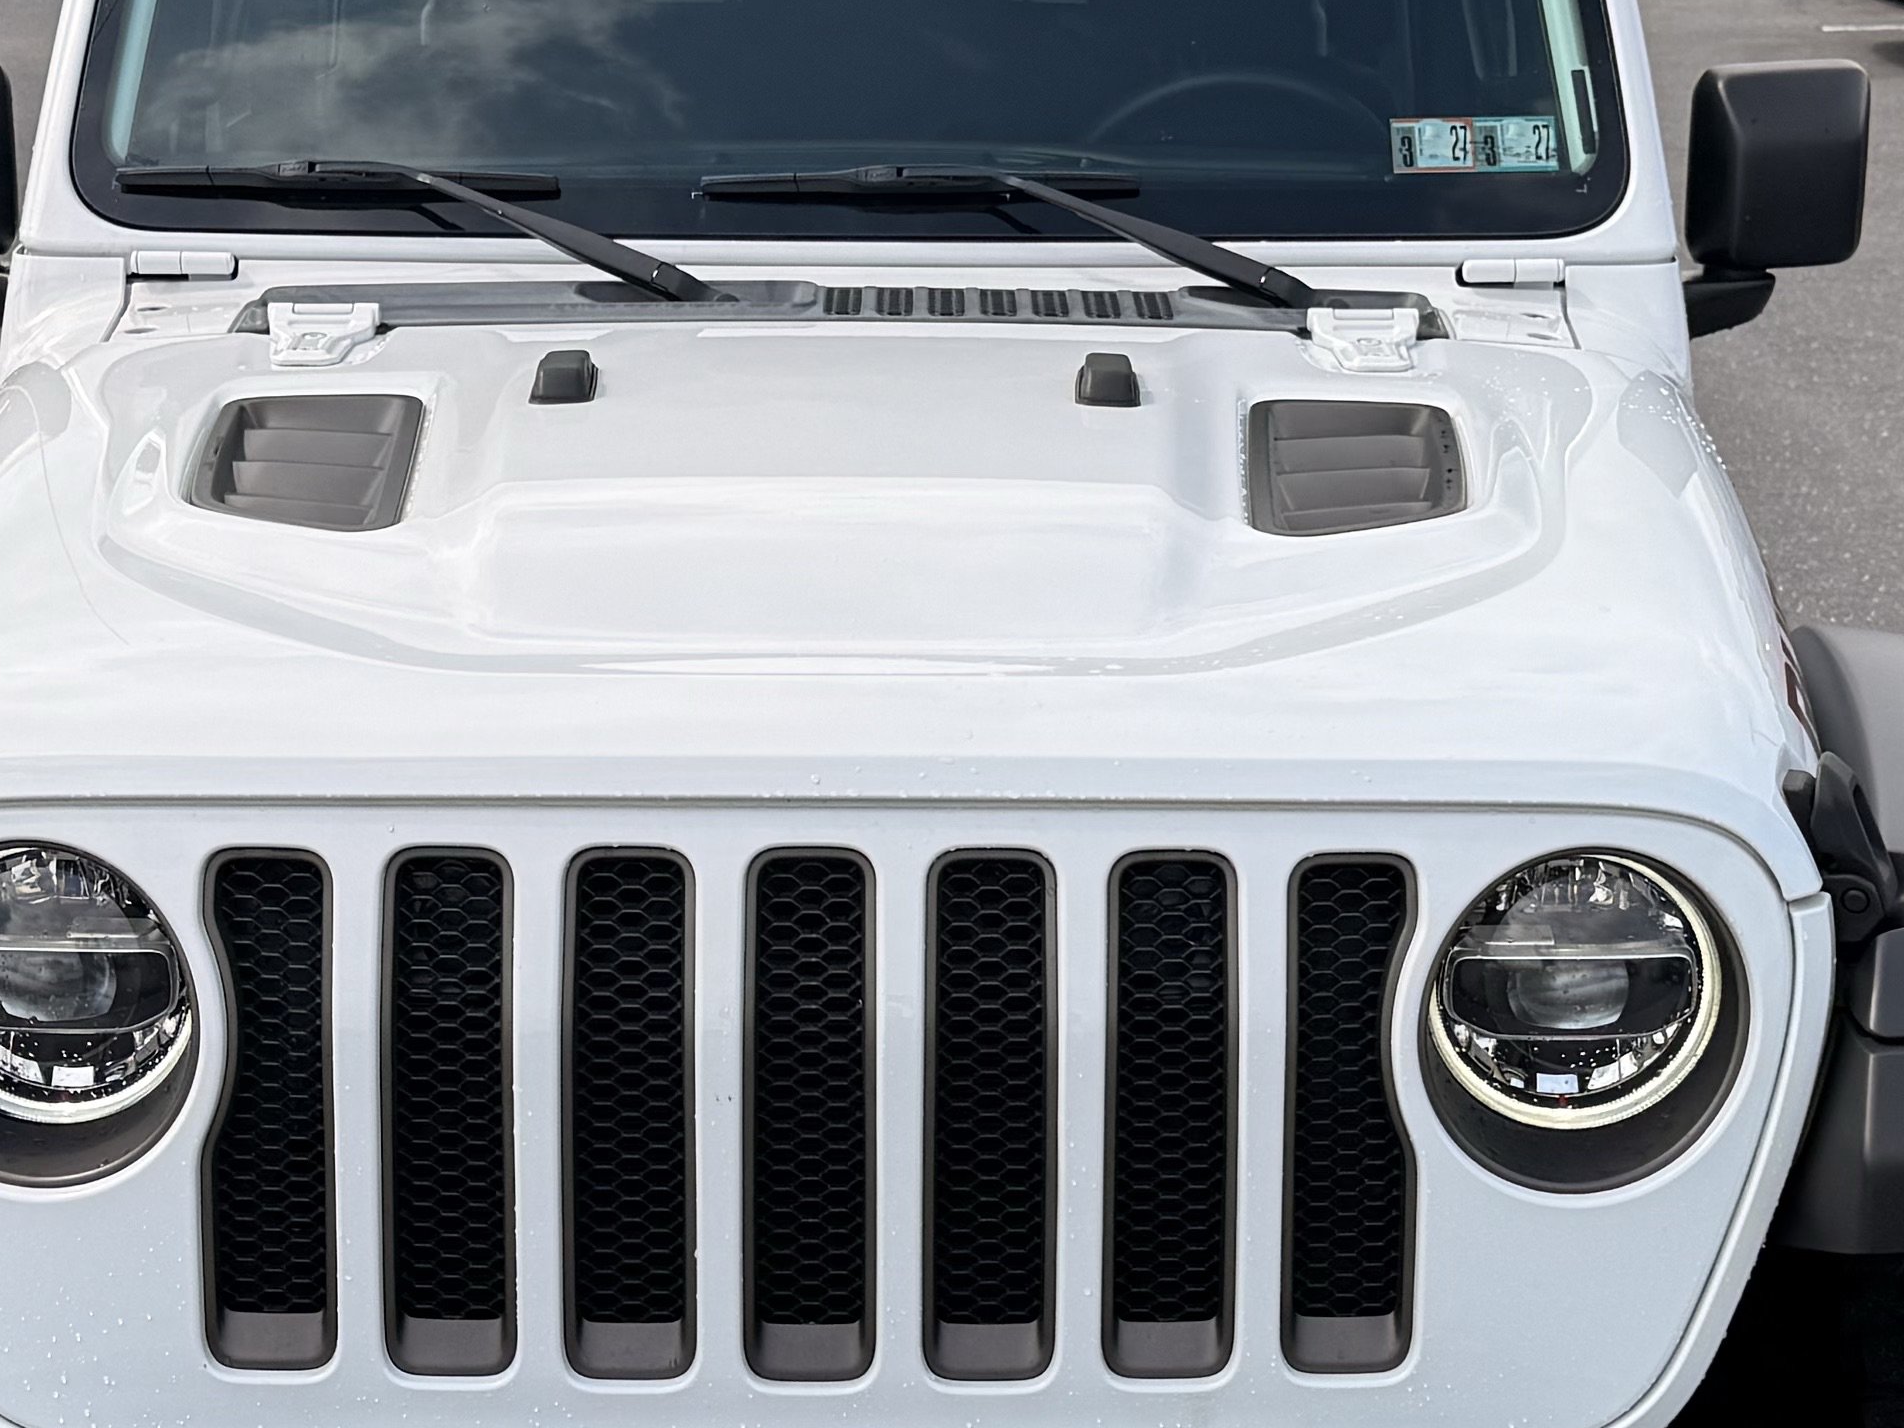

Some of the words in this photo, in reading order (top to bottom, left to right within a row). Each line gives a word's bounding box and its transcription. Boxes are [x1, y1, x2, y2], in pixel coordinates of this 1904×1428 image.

[1400, 136, 1414, 167] 3
[1449, 125, 1468, 164] 27
[1483, 135, 1497, 167] 3
[1533, 124, 1550, 160] 27
